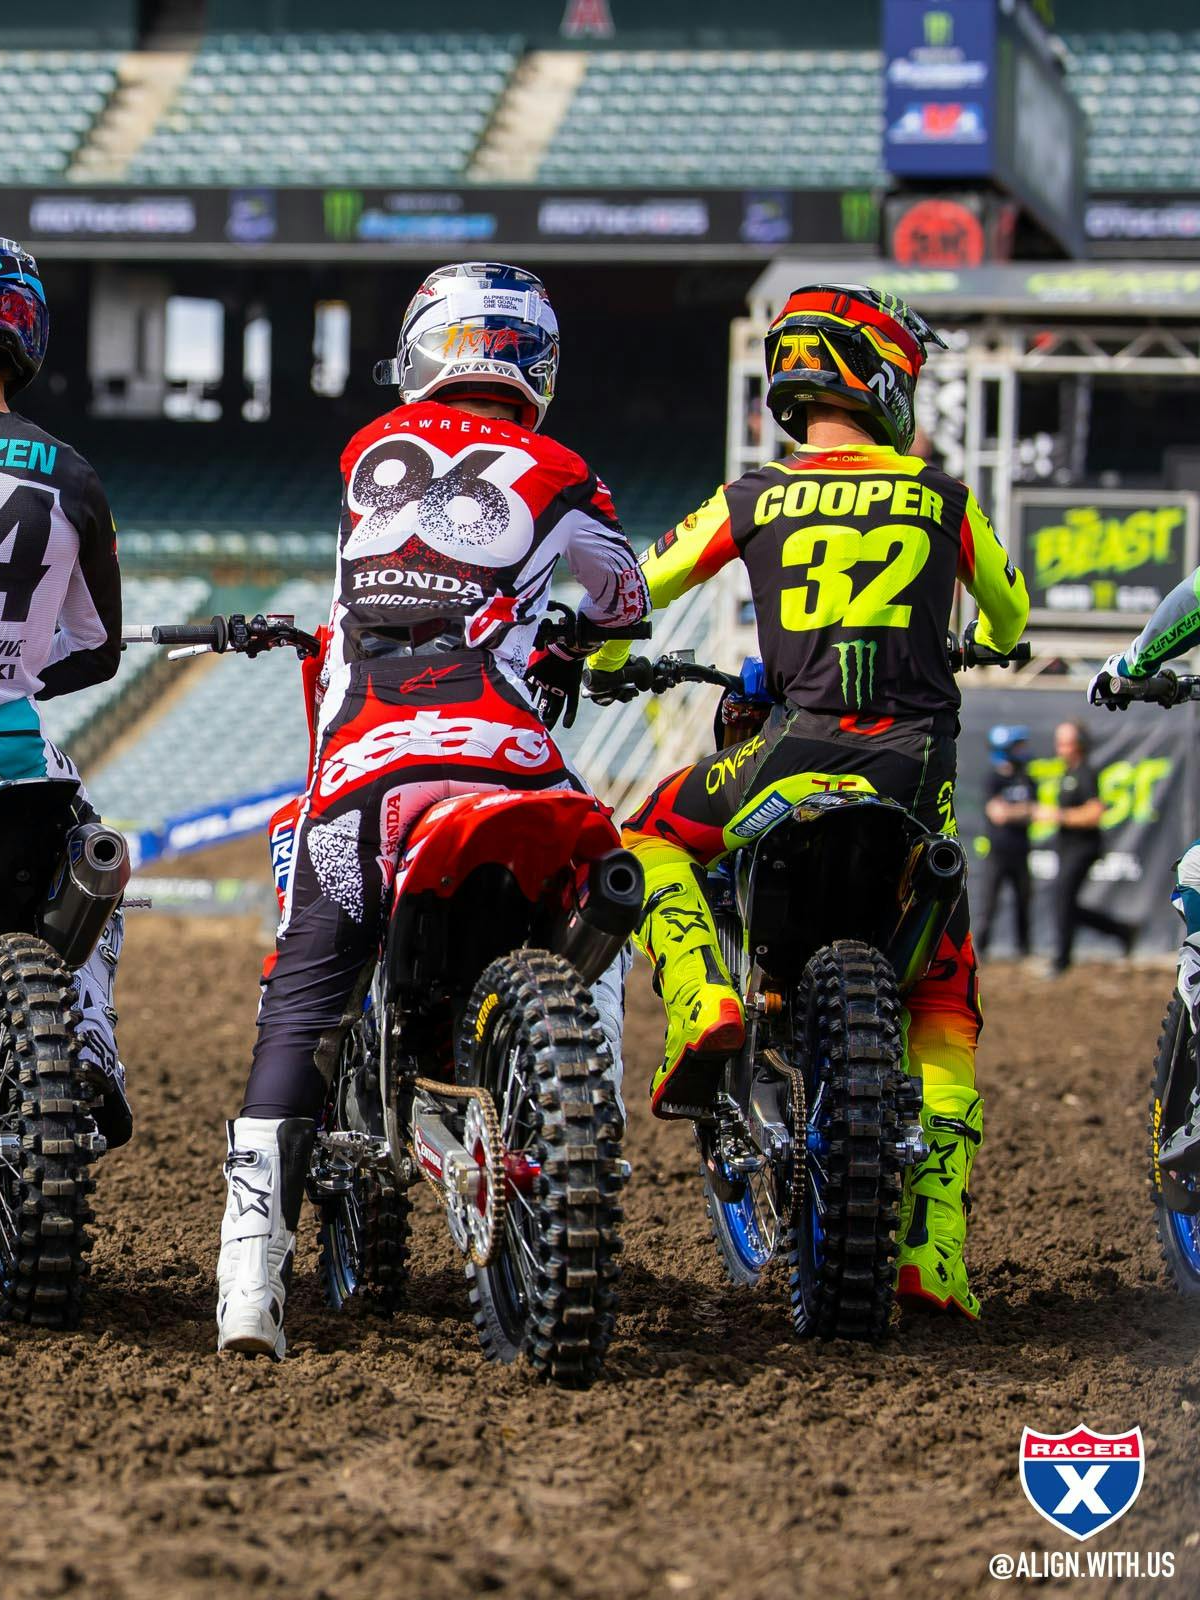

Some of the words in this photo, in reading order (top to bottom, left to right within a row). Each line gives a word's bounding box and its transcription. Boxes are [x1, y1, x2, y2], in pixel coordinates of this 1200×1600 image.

[341, 432, 538, 568] 96
[754, 480, 944, 526] COOPER
[352, 568, 484, 601] HONDA
[780, 524, 931, 632] 32
[319, 710, 552, 797] astars
[742, 797, 790, 832] YAMAHA
